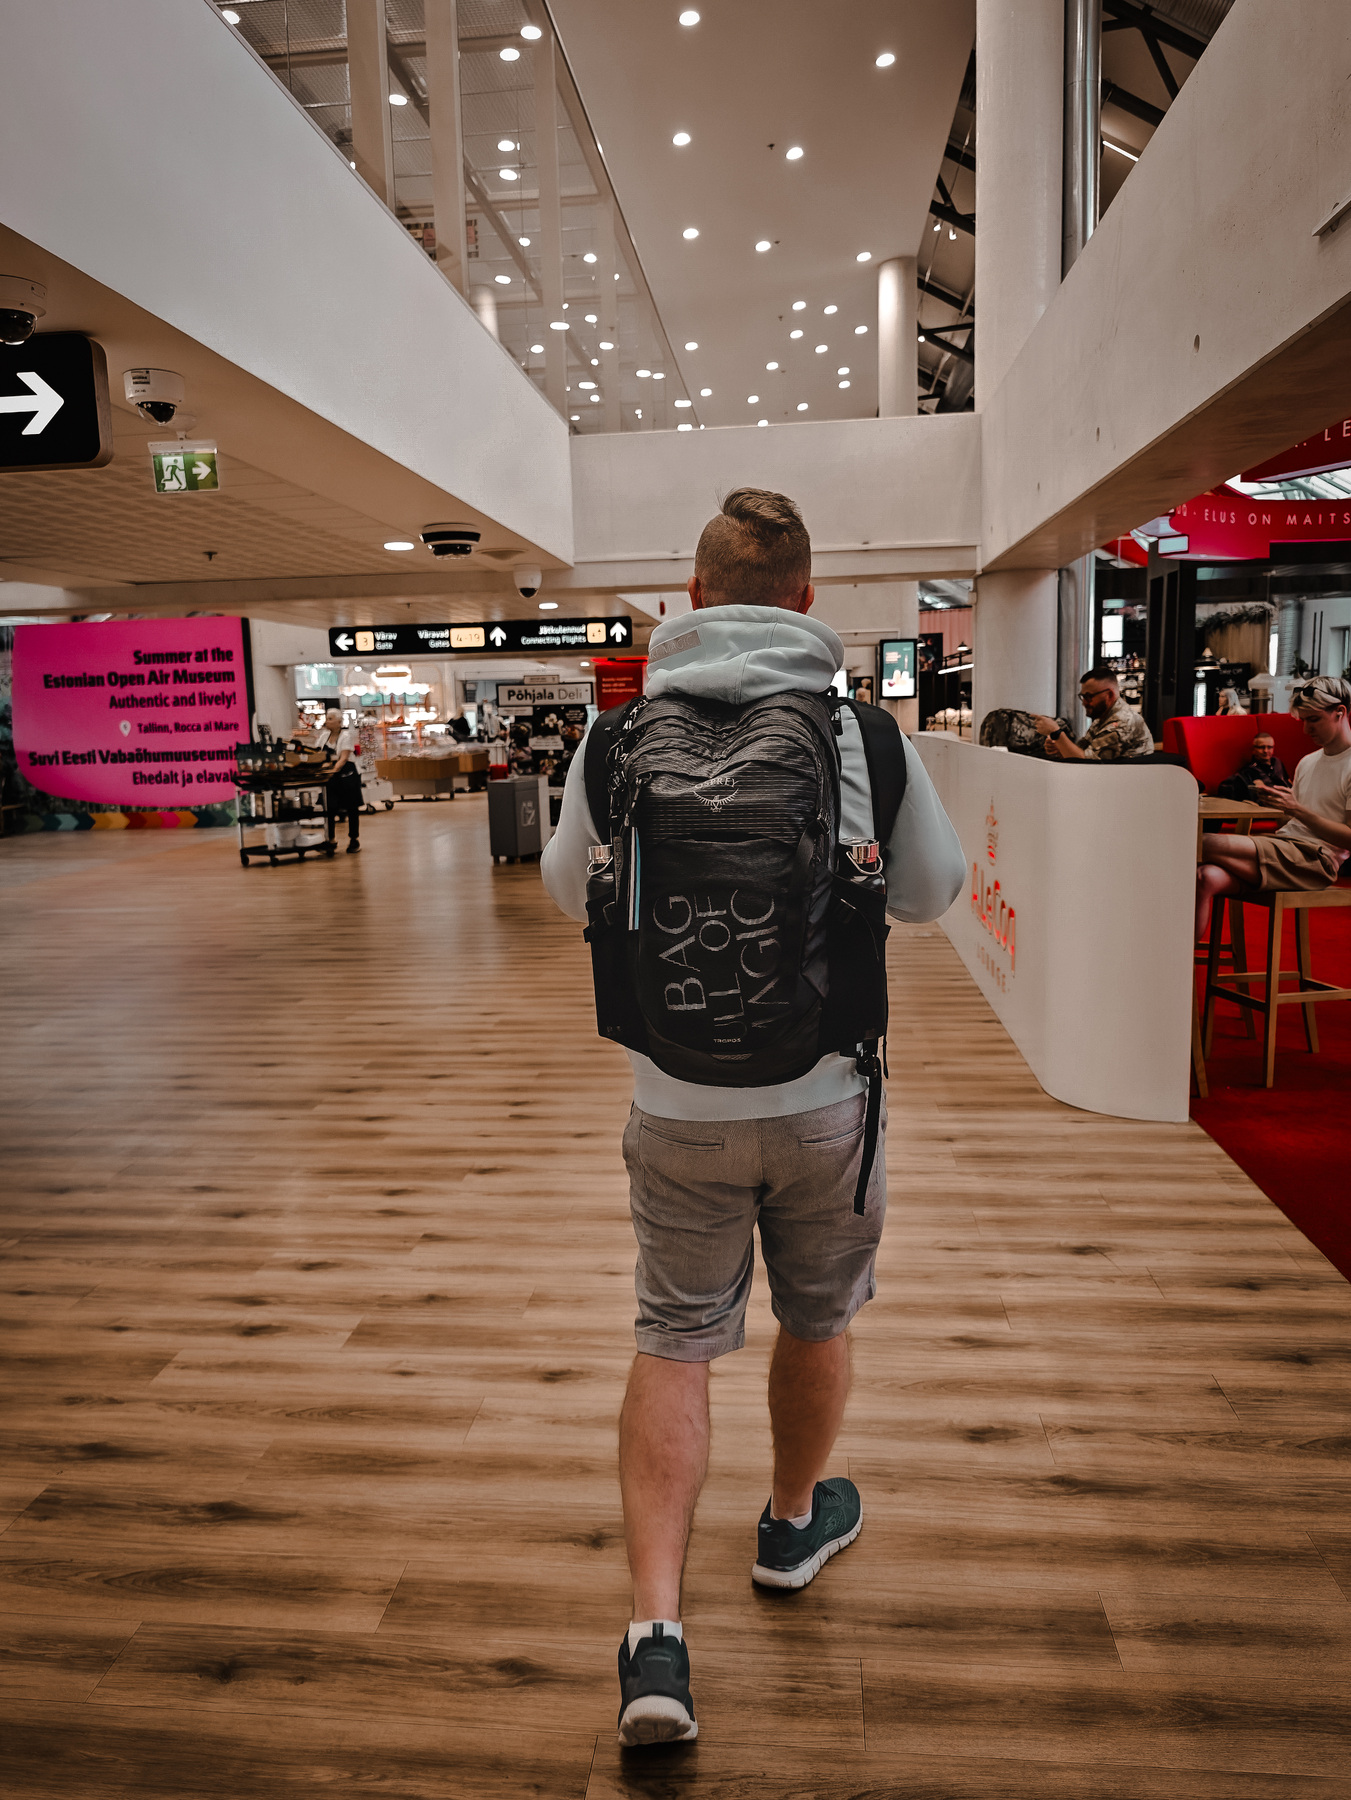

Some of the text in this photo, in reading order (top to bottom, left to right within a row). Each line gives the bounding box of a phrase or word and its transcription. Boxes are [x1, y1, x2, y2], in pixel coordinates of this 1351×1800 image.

[1204, 508, 1236, 524] ELUS
[1248, 512, 1271, 525] ON
[1286, 512, 1351, 525] MAITS
[363, 637, 369, 647] 3
[375, 641, 394, 650] Gate
[428, 639, 450, 648] Gates
[520, 634, 587, 645] Connecting Flights
[133, 647, 234, 666] Summer at the
[43, 669, 236, 689] Estonian Open Air Museum
[109, 691, 237, 709] Authentic and lively!
[507, 688, 582, 704] Põhjala Deli
[137, 720, 239, 734] Tallinn, Rocca al Mare
[28, 750, 60, 767] Suvi
[62, 749, 97, 766] Eesti
[132, 770, 180, 785] Ehedalt
[181, 770, 194, 787] ja
[694, 777, 739, 788] OSPREY
[694, 894, 731, 953] OF
[652, 894, 707, 1011] BAG
